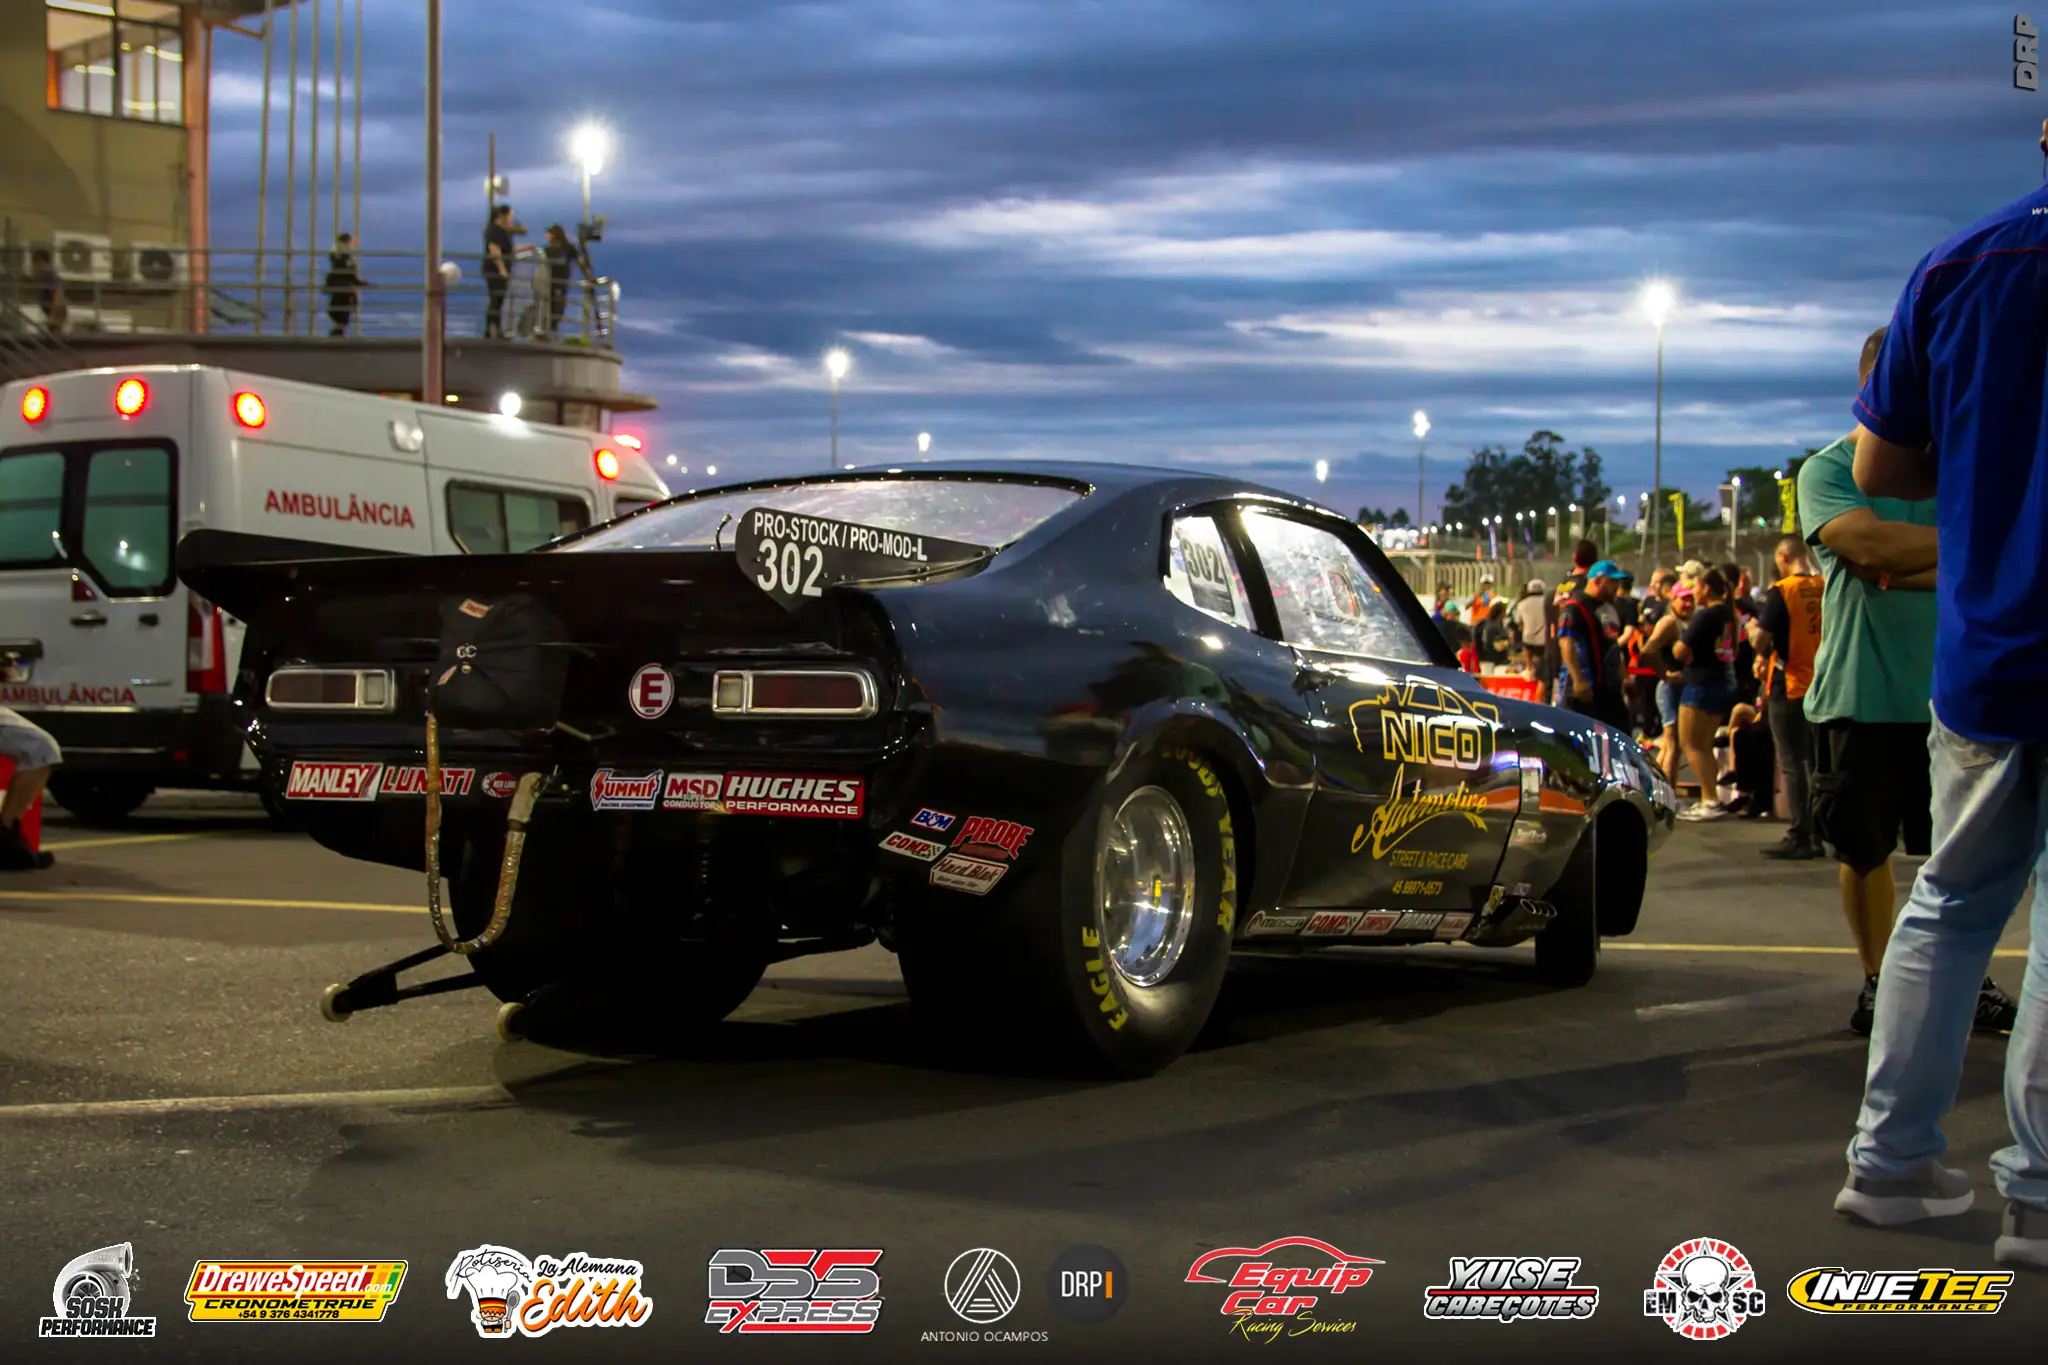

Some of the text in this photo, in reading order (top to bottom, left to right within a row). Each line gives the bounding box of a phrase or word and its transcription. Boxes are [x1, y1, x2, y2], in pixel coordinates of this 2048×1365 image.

[265, 488, 415, 529] AMBULÂNCIA
[754, 511, 840, 547] PRO-STOCK
[850, 526, 928, 562] PRO-MOD-L
[757, 538, 824, 597] 302
[1181, 538, 1225, 584] 302
[0, 683, 138, 704] AMBULÂNCIA
[639, 673, 665, 708] E
[1381, 709, 1481, 771] NICO
[289, 767, 370, 794] MANLEY
[380, 766, 476, 796] LUNTI
[592, 770, 656, 803] SUMMIT
[667, 777, 719, 798] MSD
[726, 776, 860, 803] HUGHES
[726, 801, 858, 815] PERFORMANCE
[914, 810, 954, 830] B&M
[1351, 762, 1488, 860] Automotive
[886, 834, 932, 854] COMP
[952, 816, 1035, 860] PROBE
[1389, 850, 1420, 867] STREET
[1307, 914, 1349, 933] COMP
[1082, 926, 1129, 1030] EAGLE
